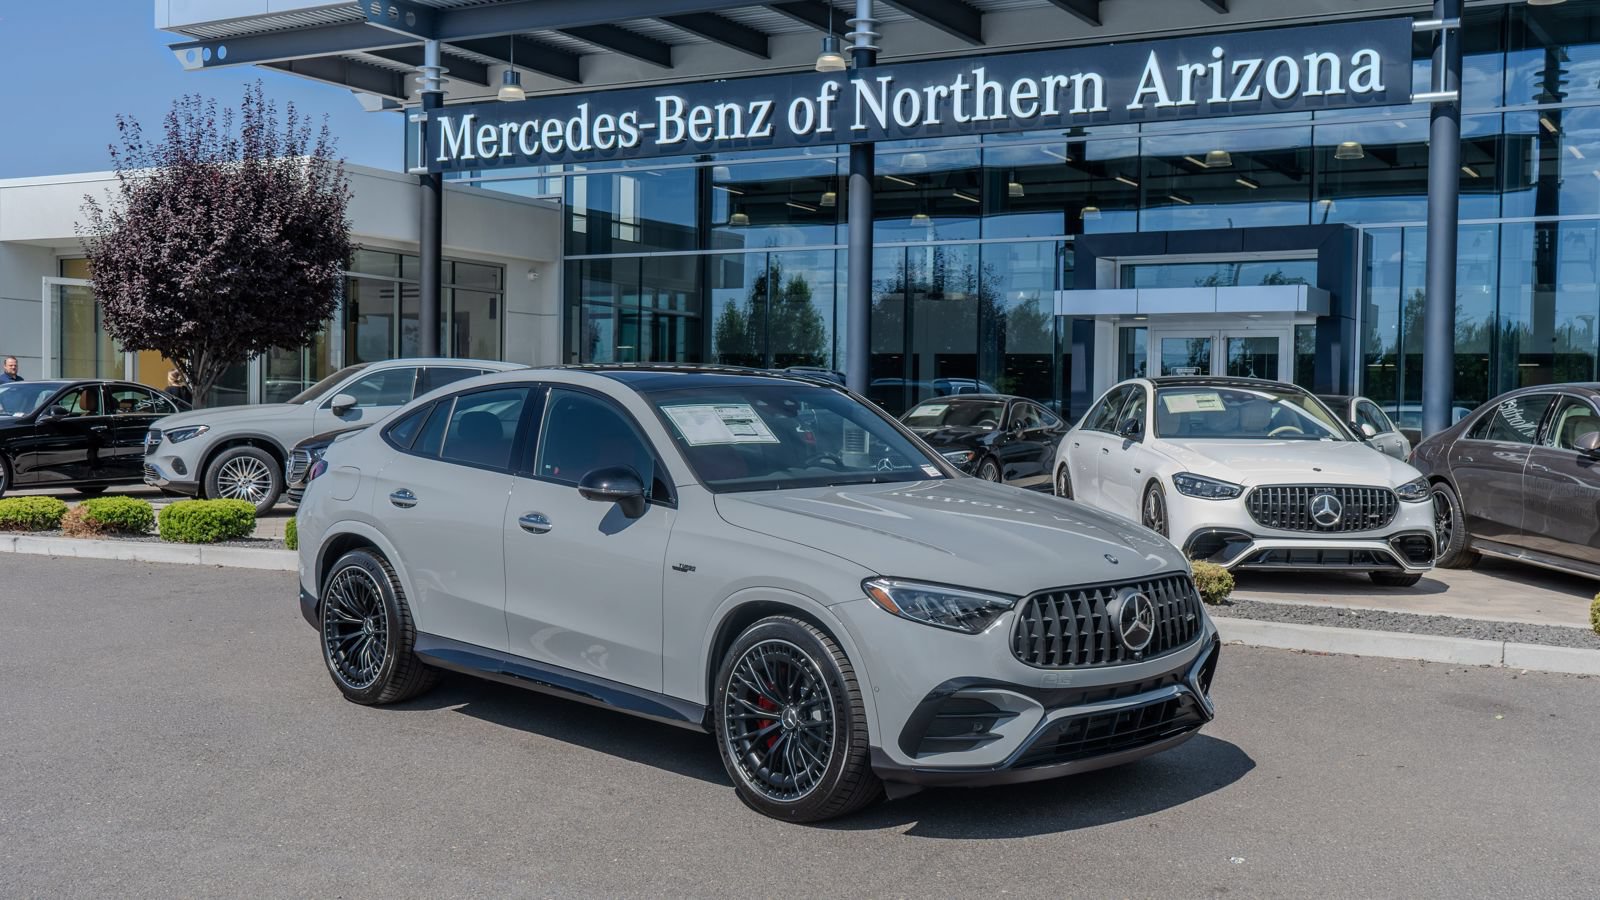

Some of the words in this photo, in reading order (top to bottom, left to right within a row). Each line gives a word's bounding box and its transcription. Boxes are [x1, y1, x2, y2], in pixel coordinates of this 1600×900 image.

[436, 94, 775, 163] Mercedes-Benz
[788, 80, 839, 136] of
[850, 66, 1108, 132] Northern
[1126, 45, 1385, 112] Arizona
